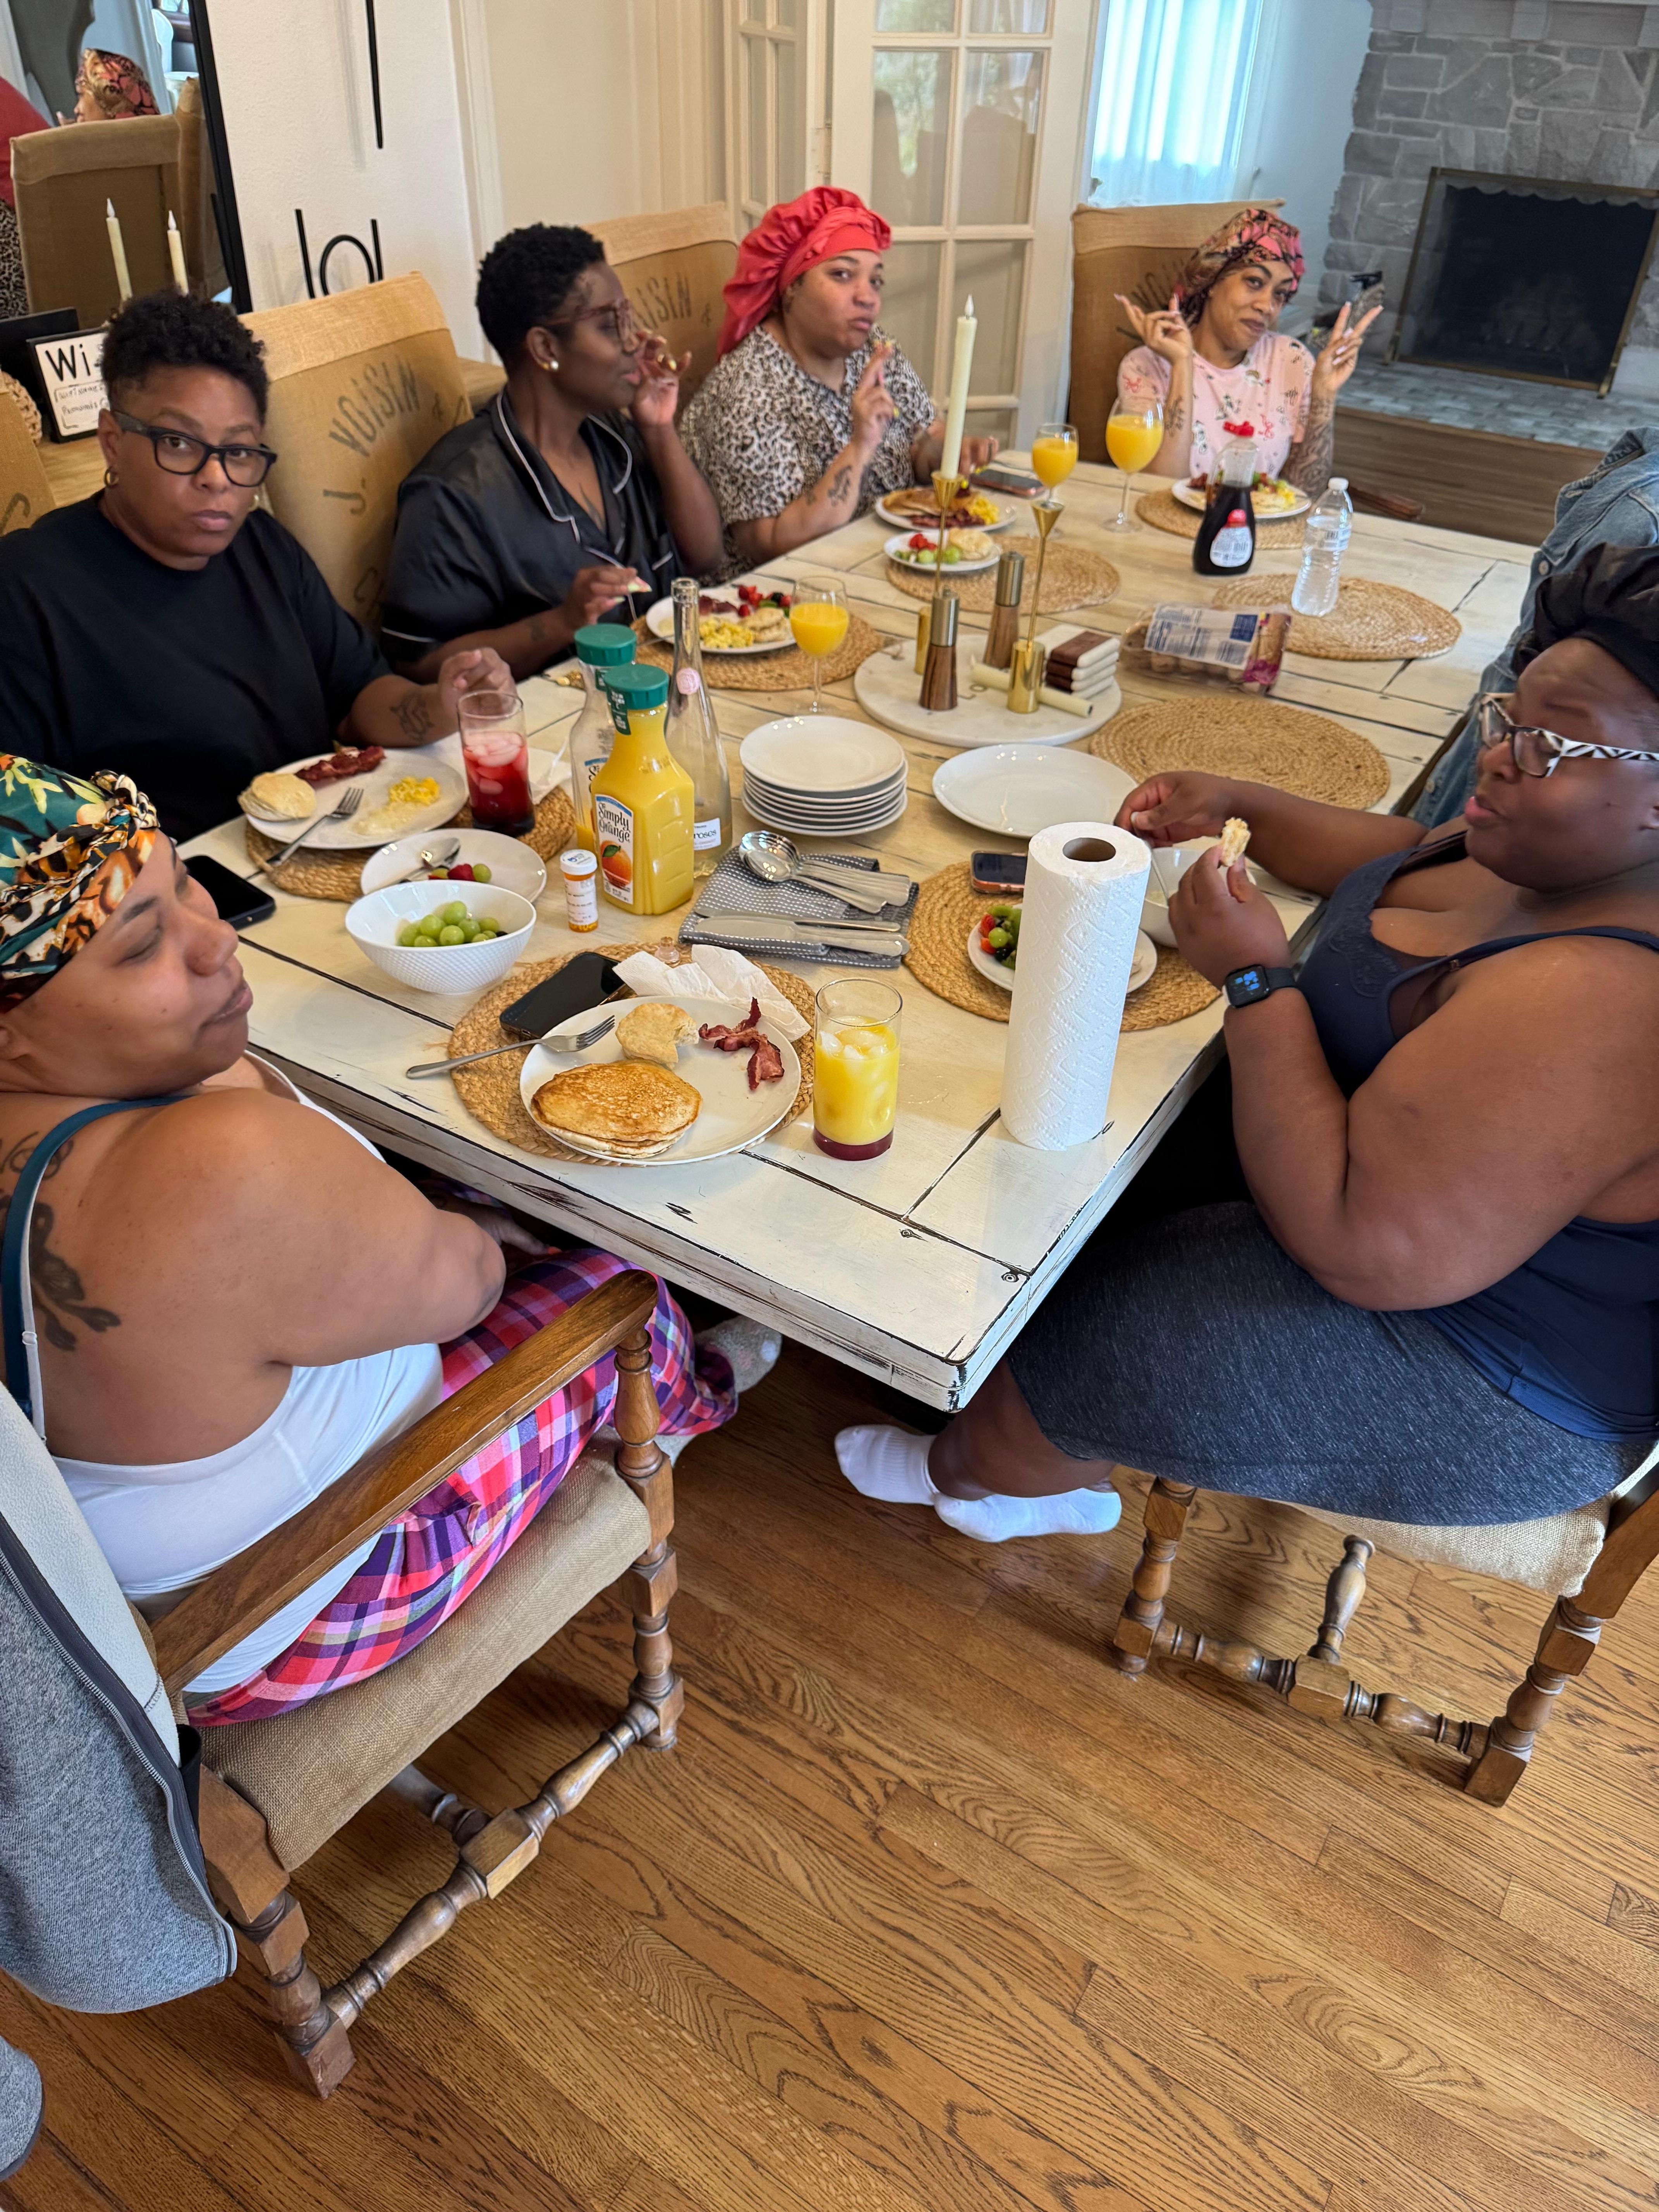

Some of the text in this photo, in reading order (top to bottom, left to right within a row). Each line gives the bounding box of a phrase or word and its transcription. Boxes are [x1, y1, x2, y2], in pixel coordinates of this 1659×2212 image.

[328, 354, 420, 458] VOISIN
[599, 802, 630, 833] Simply
[599, 819, 630, 843] Orange
